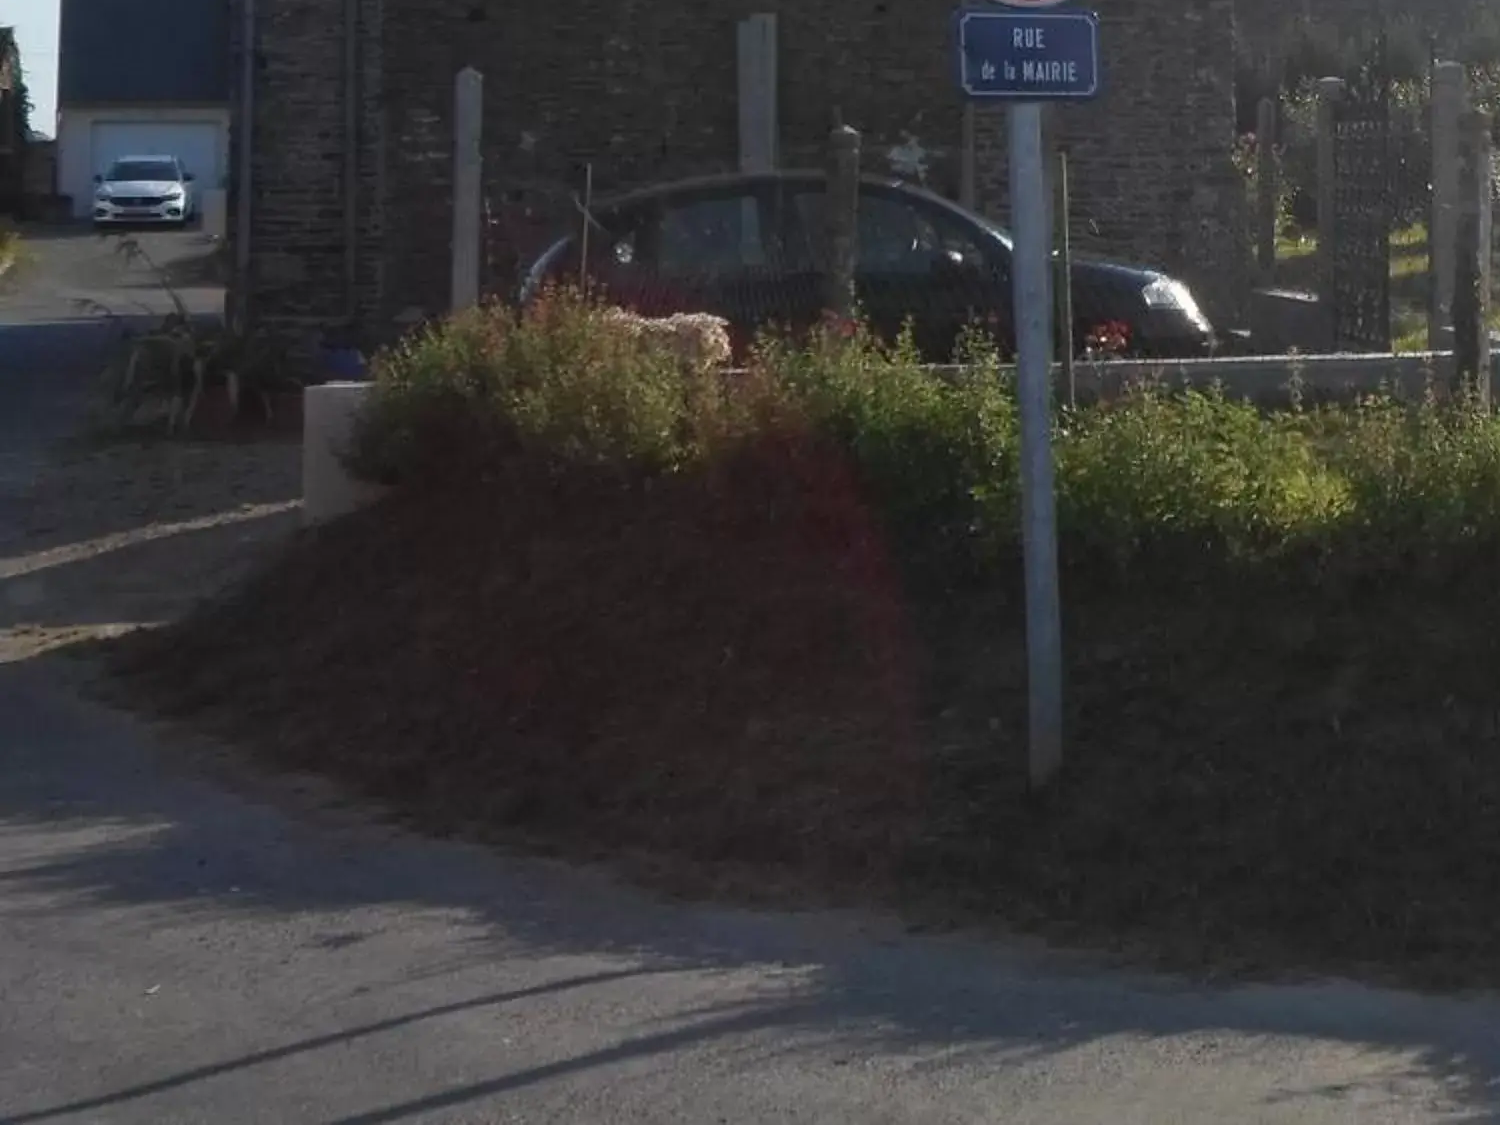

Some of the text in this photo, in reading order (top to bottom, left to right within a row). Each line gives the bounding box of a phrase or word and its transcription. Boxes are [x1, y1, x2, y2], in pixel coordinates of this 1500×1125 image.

[1013, 27, 1046, 48] RUE
[981, 59, 1078, 82] de la MAIRIE
